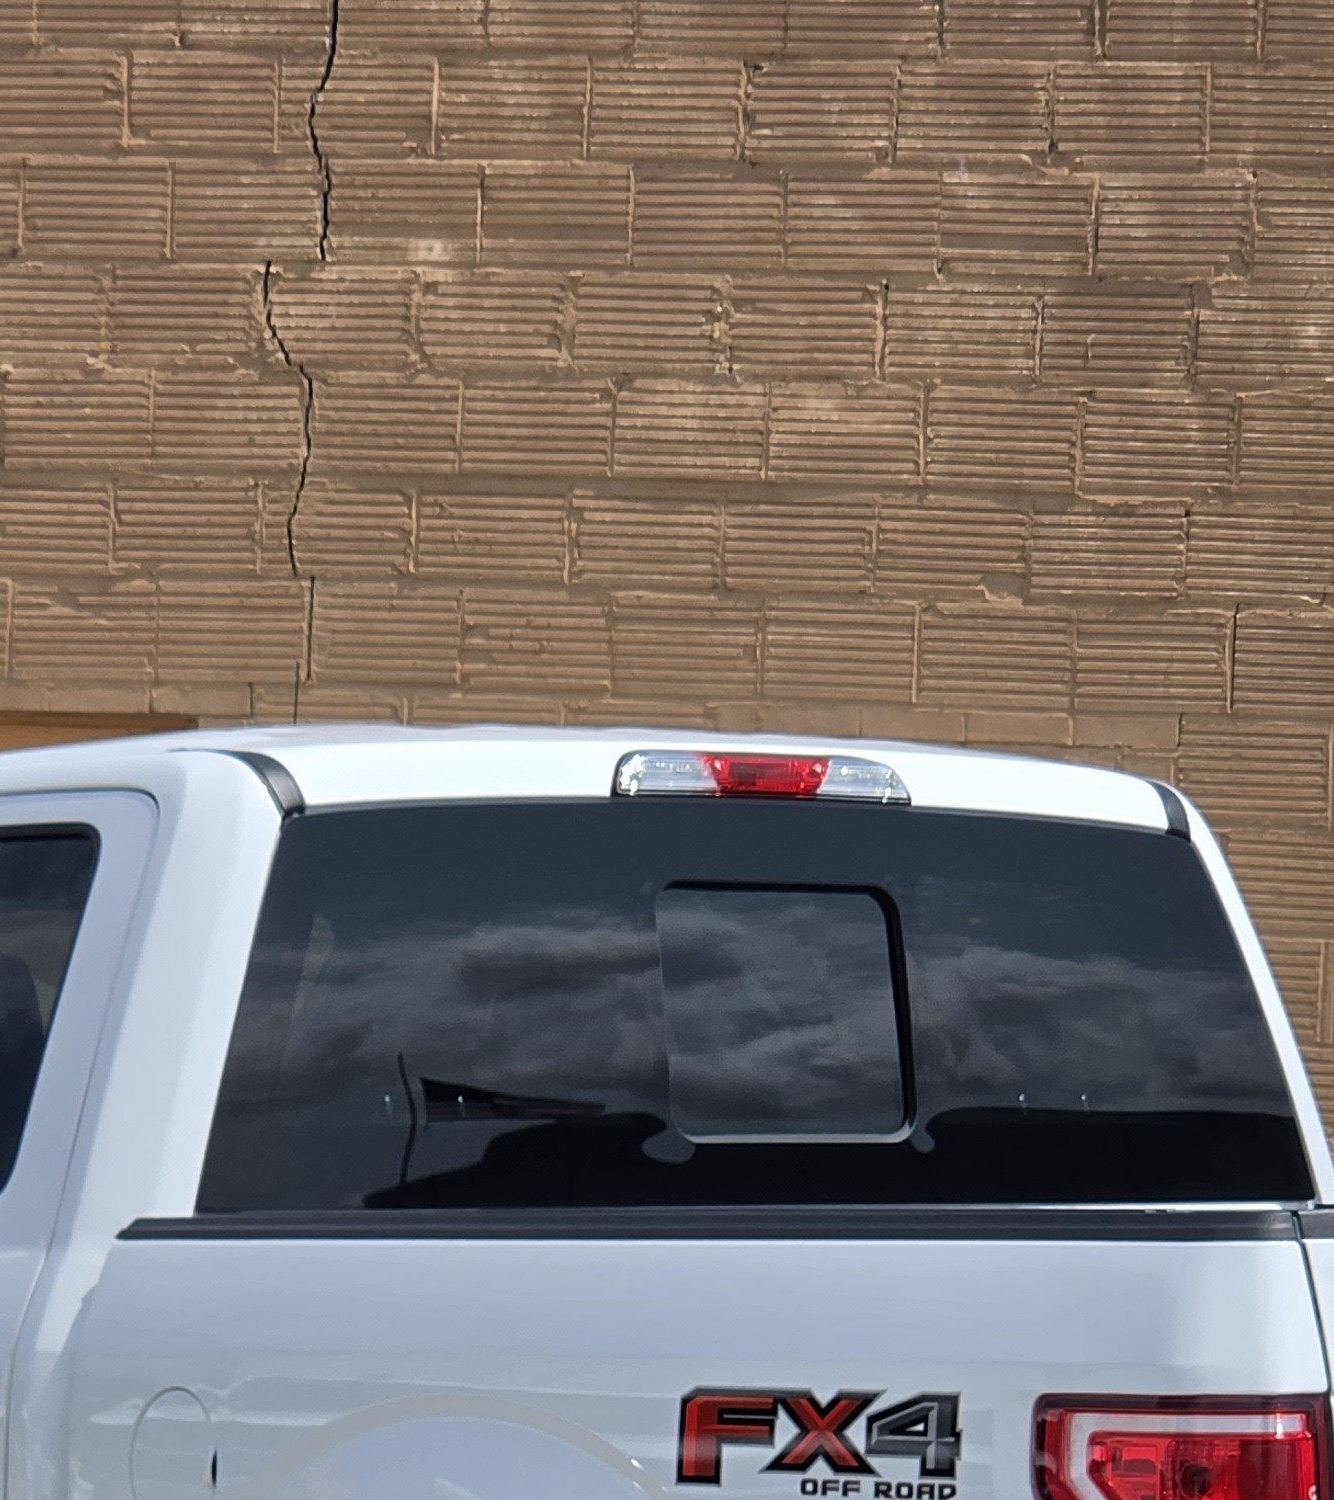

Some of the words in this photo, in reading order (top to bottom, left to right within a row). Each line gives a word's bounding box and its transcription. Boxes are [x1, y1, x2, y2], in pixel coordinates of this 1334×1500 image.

[675, 1385, 963, 1487] FX4
[800, 1478, 861, 1497] OFF
[873, 1481, 957, 1500] ROAD
